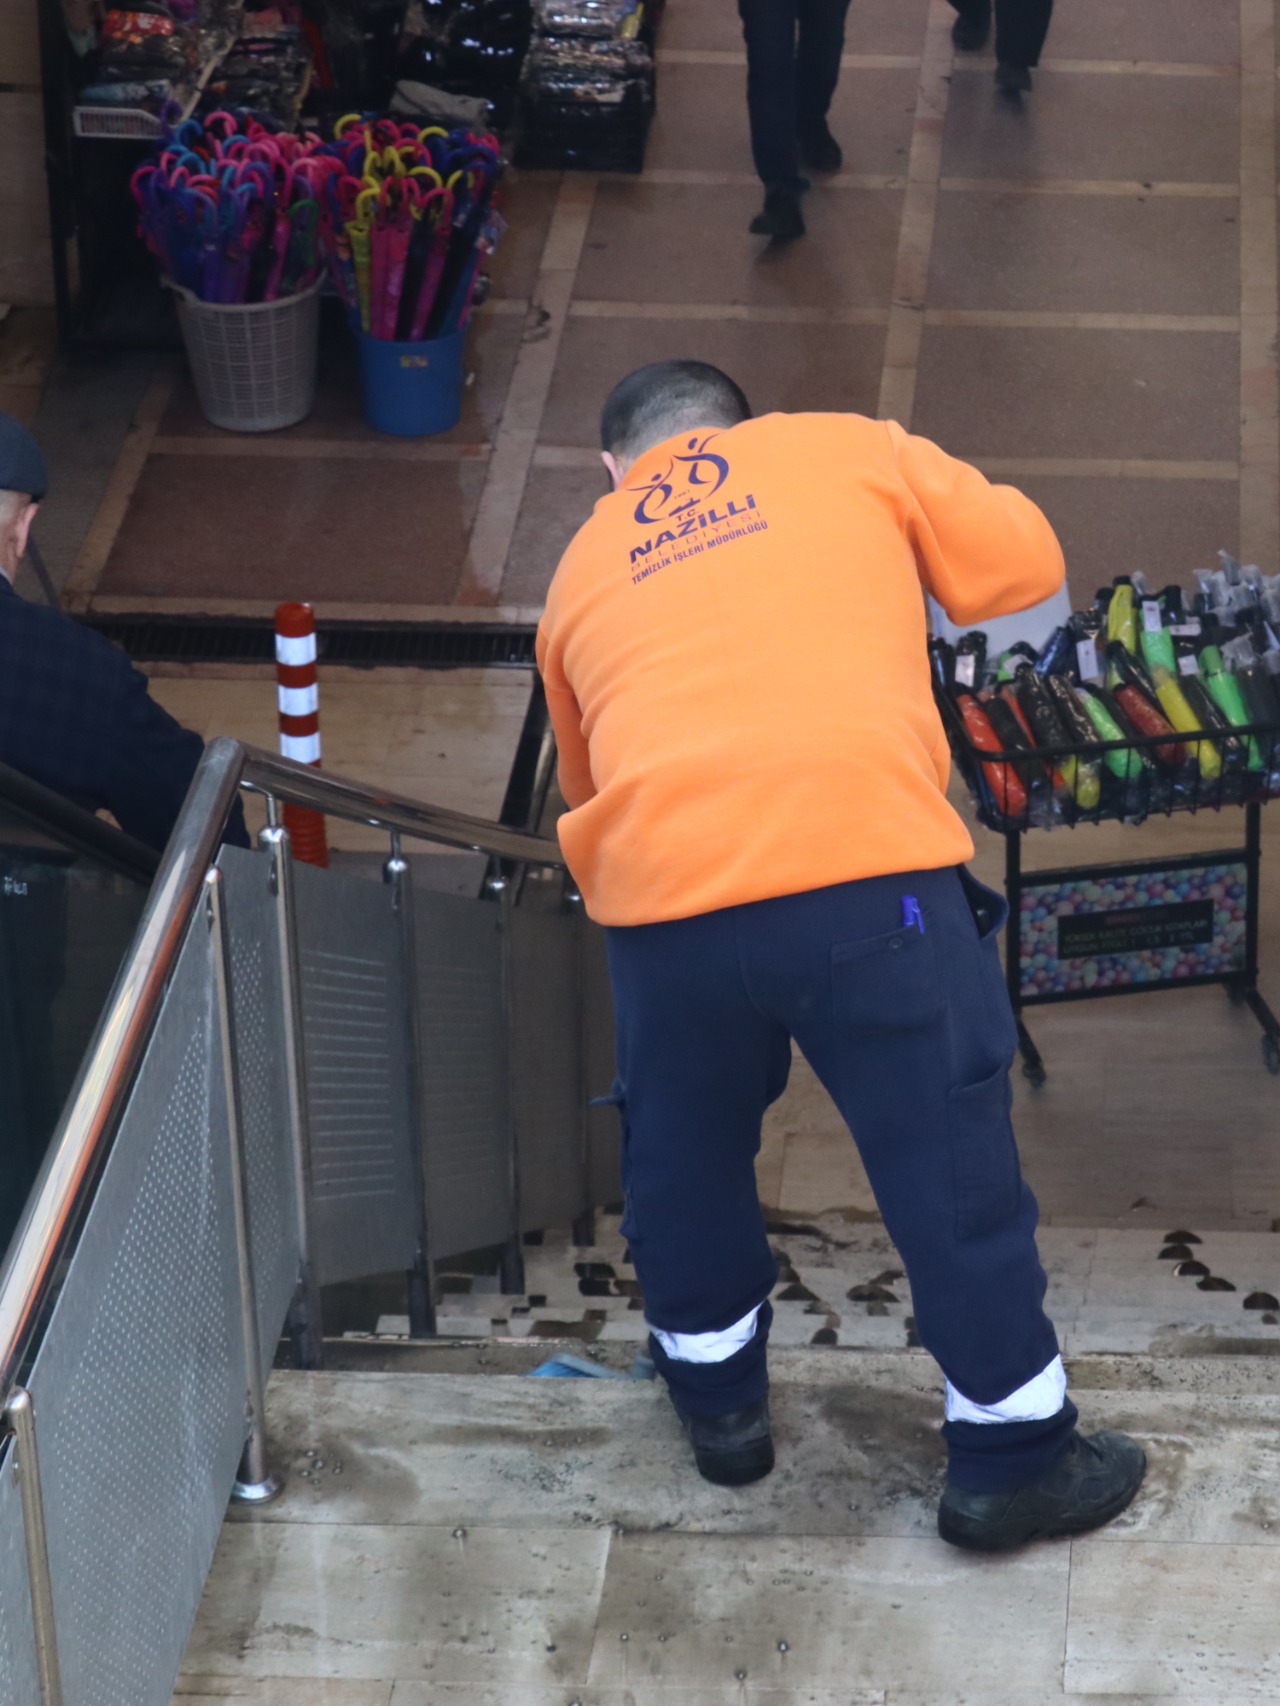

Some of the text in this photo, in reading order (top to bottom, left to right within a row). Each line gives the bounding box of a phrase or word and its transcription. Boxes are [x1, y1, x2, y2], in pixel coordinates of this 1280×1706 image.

[631, 519, 769, 585] TEMİZLİK İŞLERİ MÜDÜRLÜĞÜ
